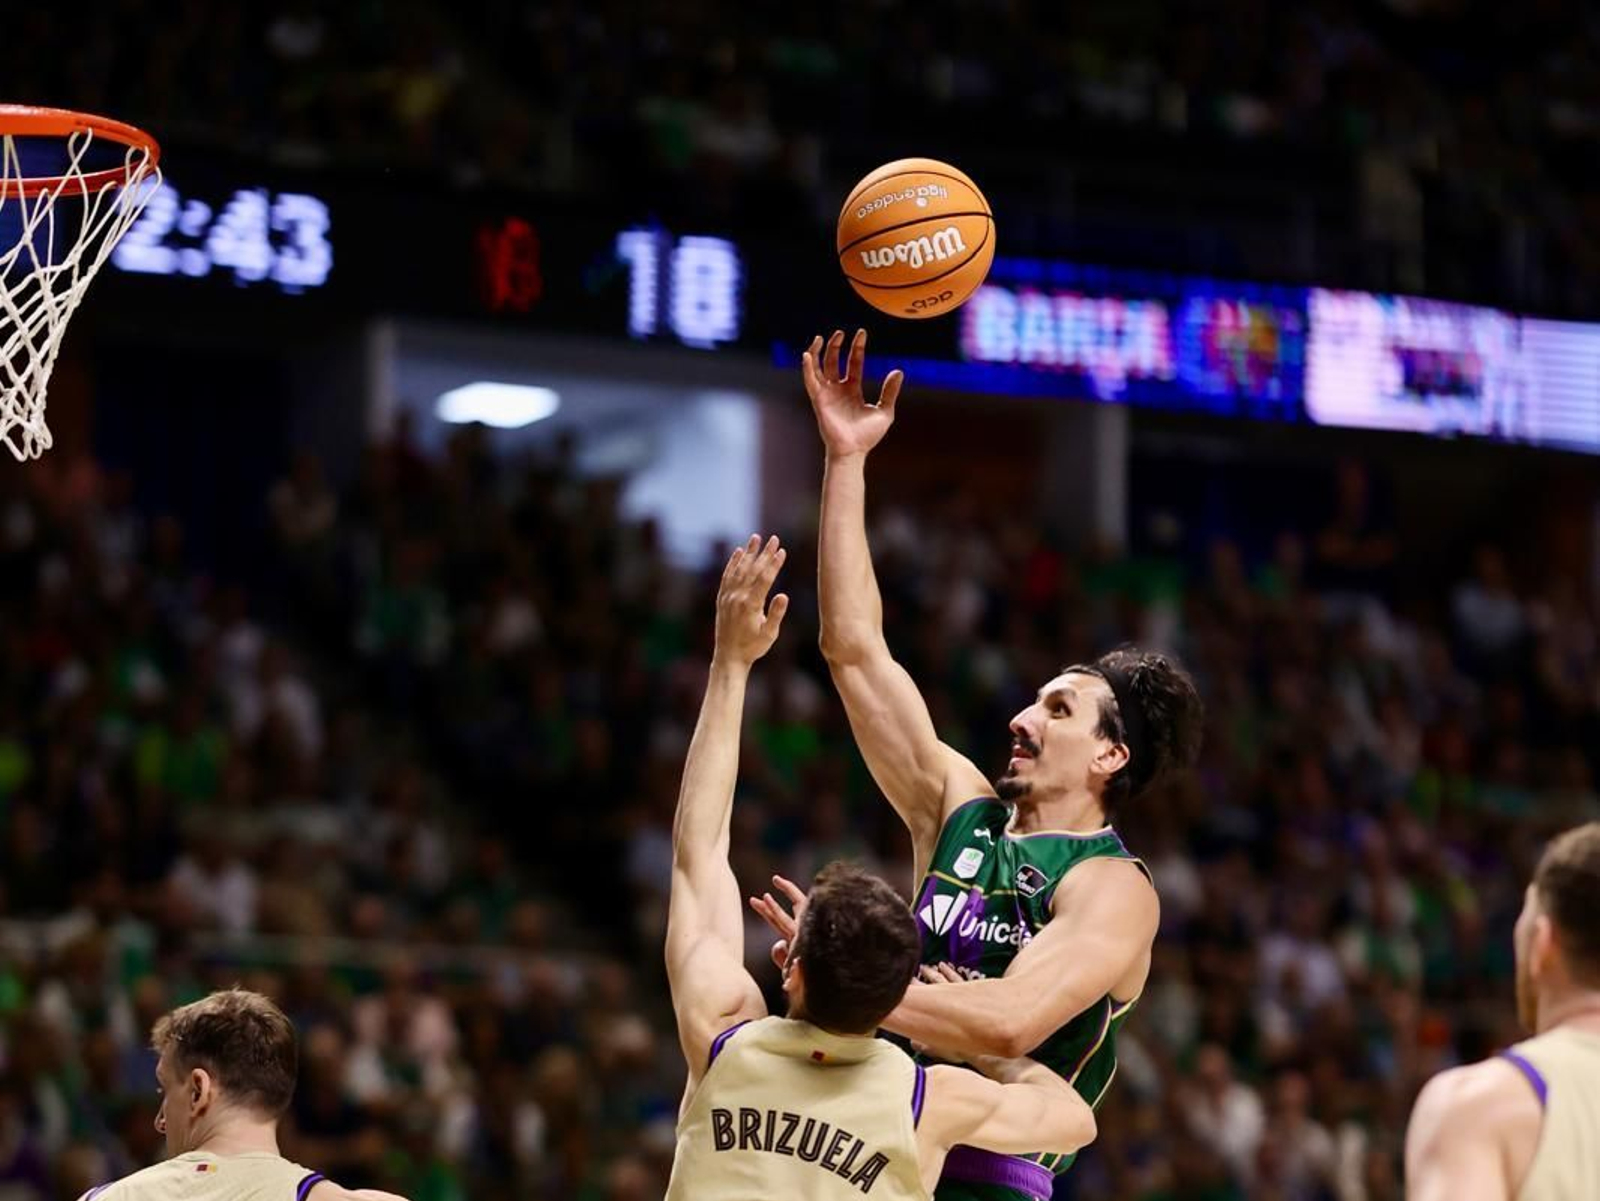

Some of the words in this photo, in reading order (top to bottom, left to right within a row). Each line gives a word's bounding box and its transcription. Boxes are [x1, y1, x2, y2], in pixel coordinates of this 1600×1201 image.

[860, 226, 967, 269] Wilson
[911, 290, 955, 310] acb
[711, 1107, 891, 1195] BRIZUELA
